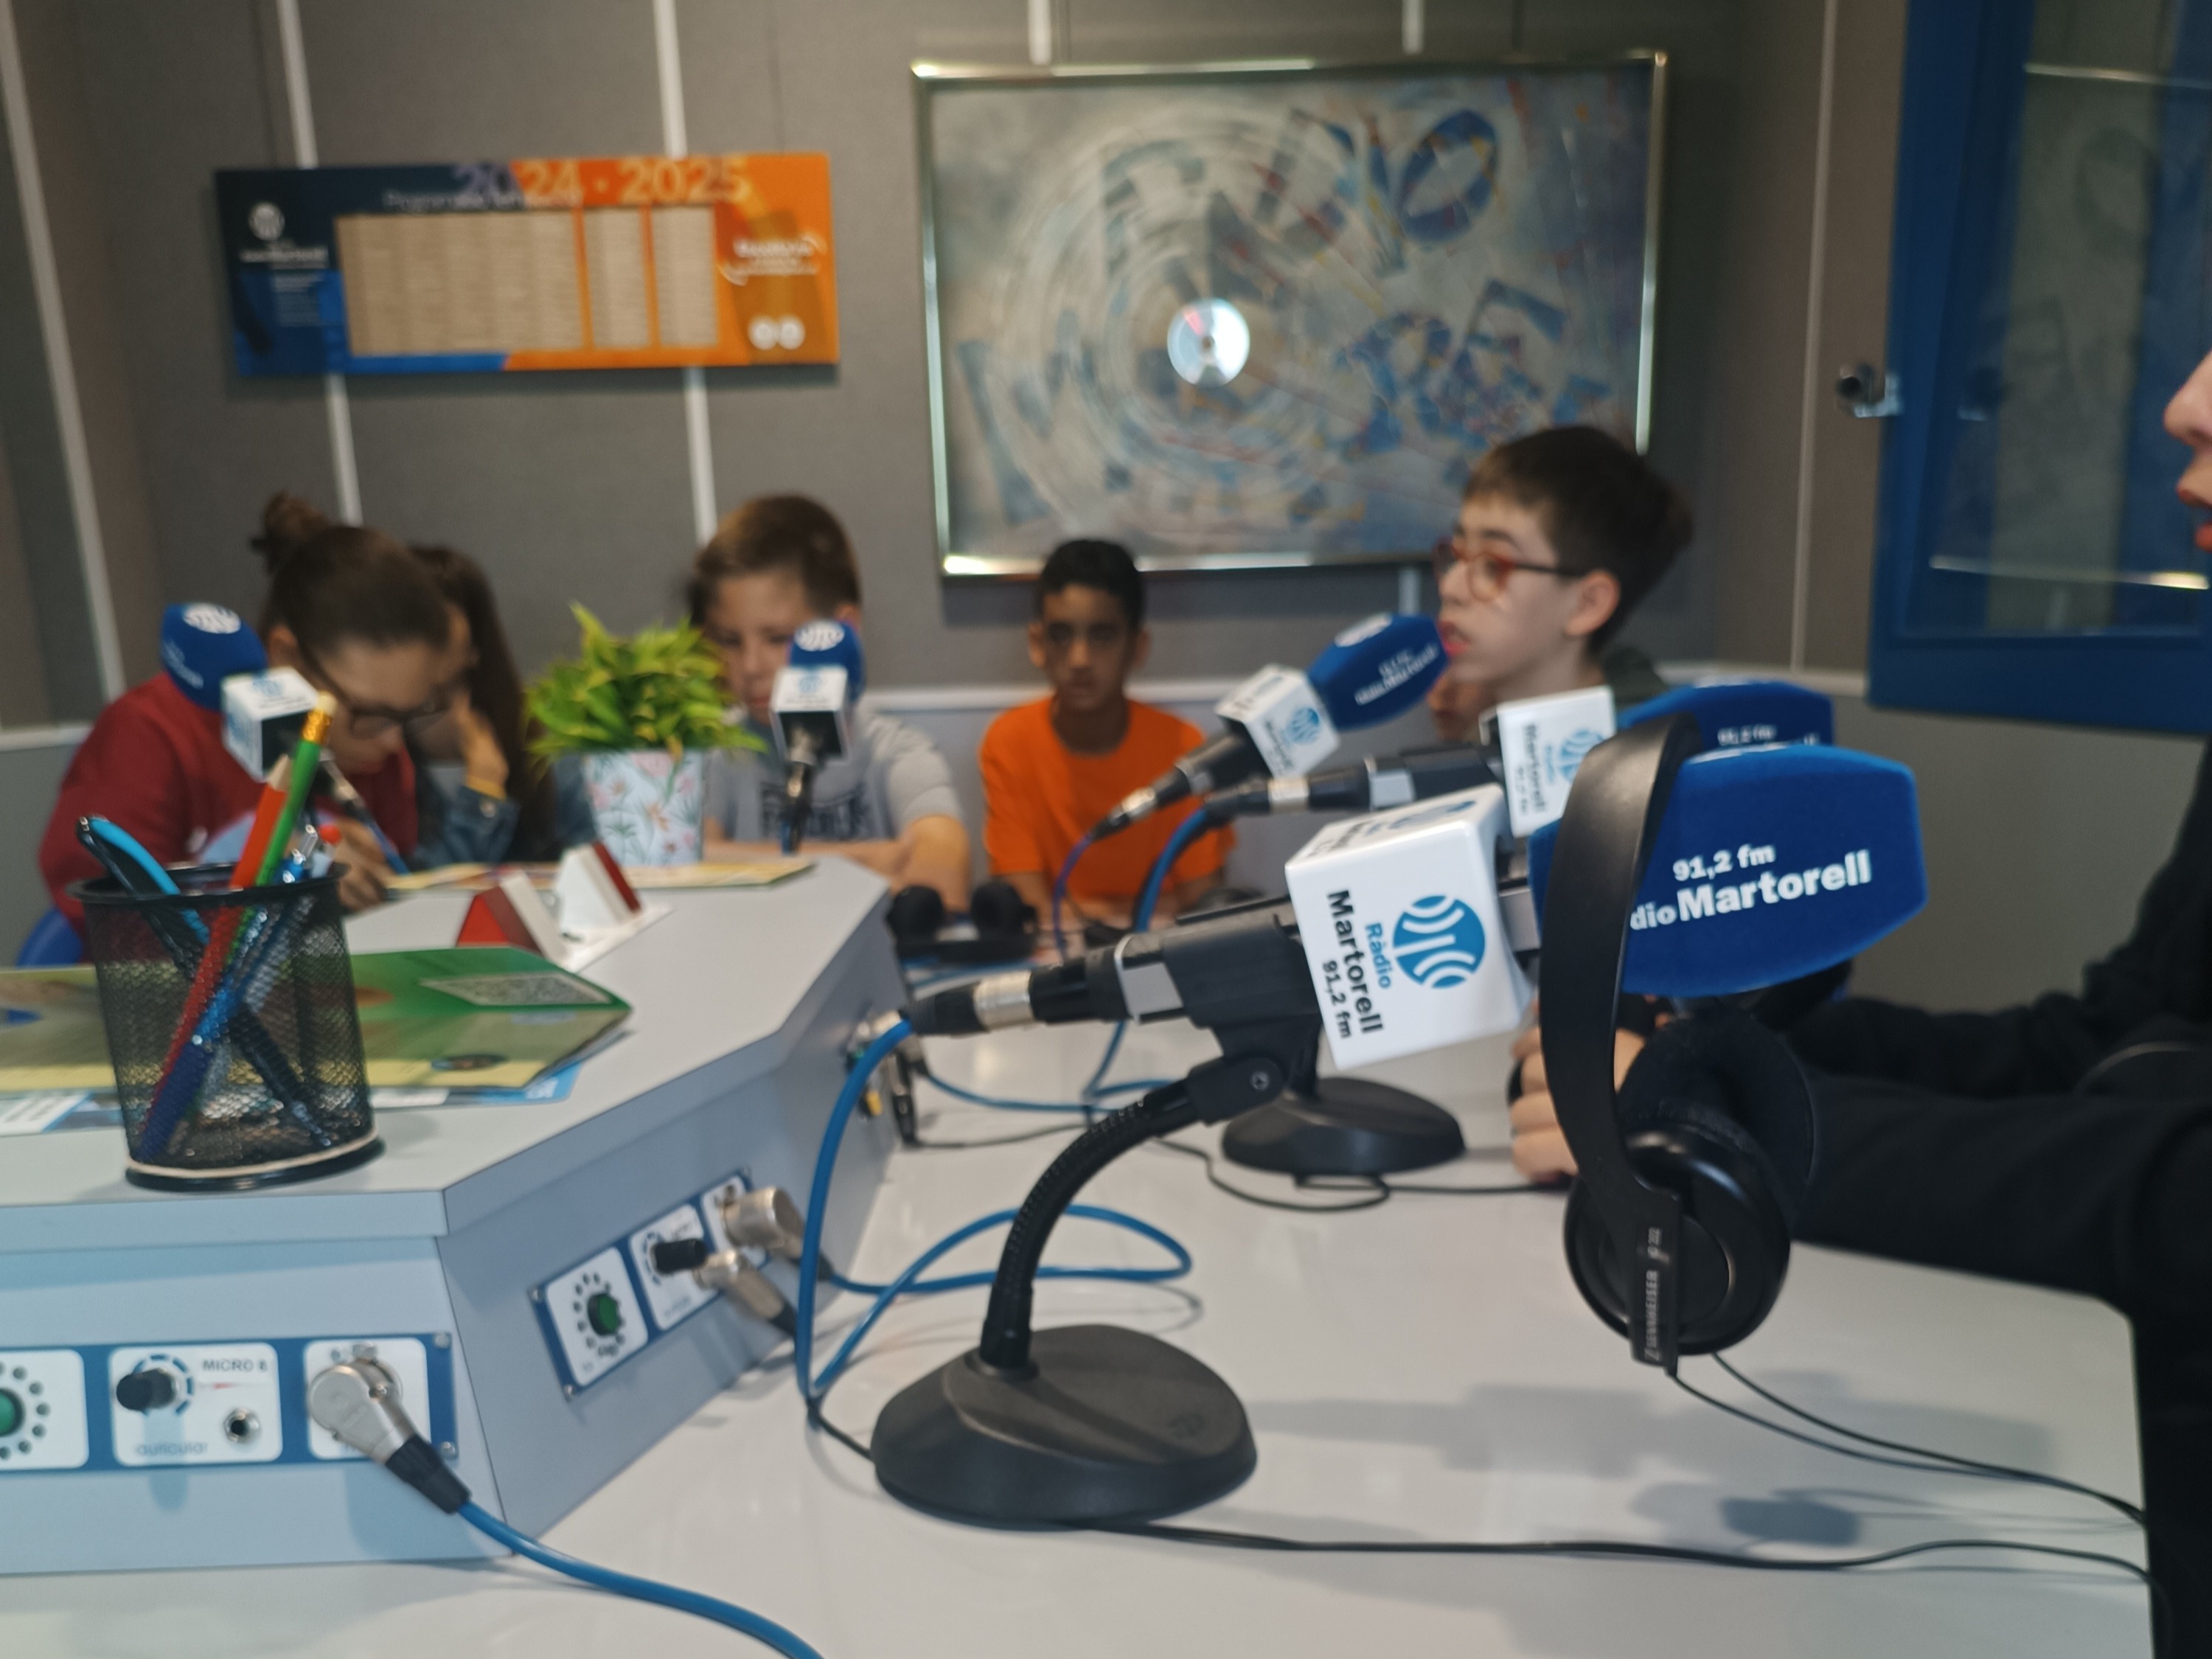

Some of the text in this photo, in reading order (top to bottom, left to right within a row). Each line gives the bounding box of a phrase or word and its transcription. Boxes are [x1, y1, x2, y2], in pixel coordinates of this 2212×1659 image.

[617, 156, 751, 203] 2025
[1630, 849, 1872, 930] dio Martorell
[1673, 844, 1775, 881] 91,2 fm
[1327, 890, 1385, 1034] Martorell
[1323, 960, 1352, 1038] 91,2 fm
[202, 1359, 254, 1373] MICRO
